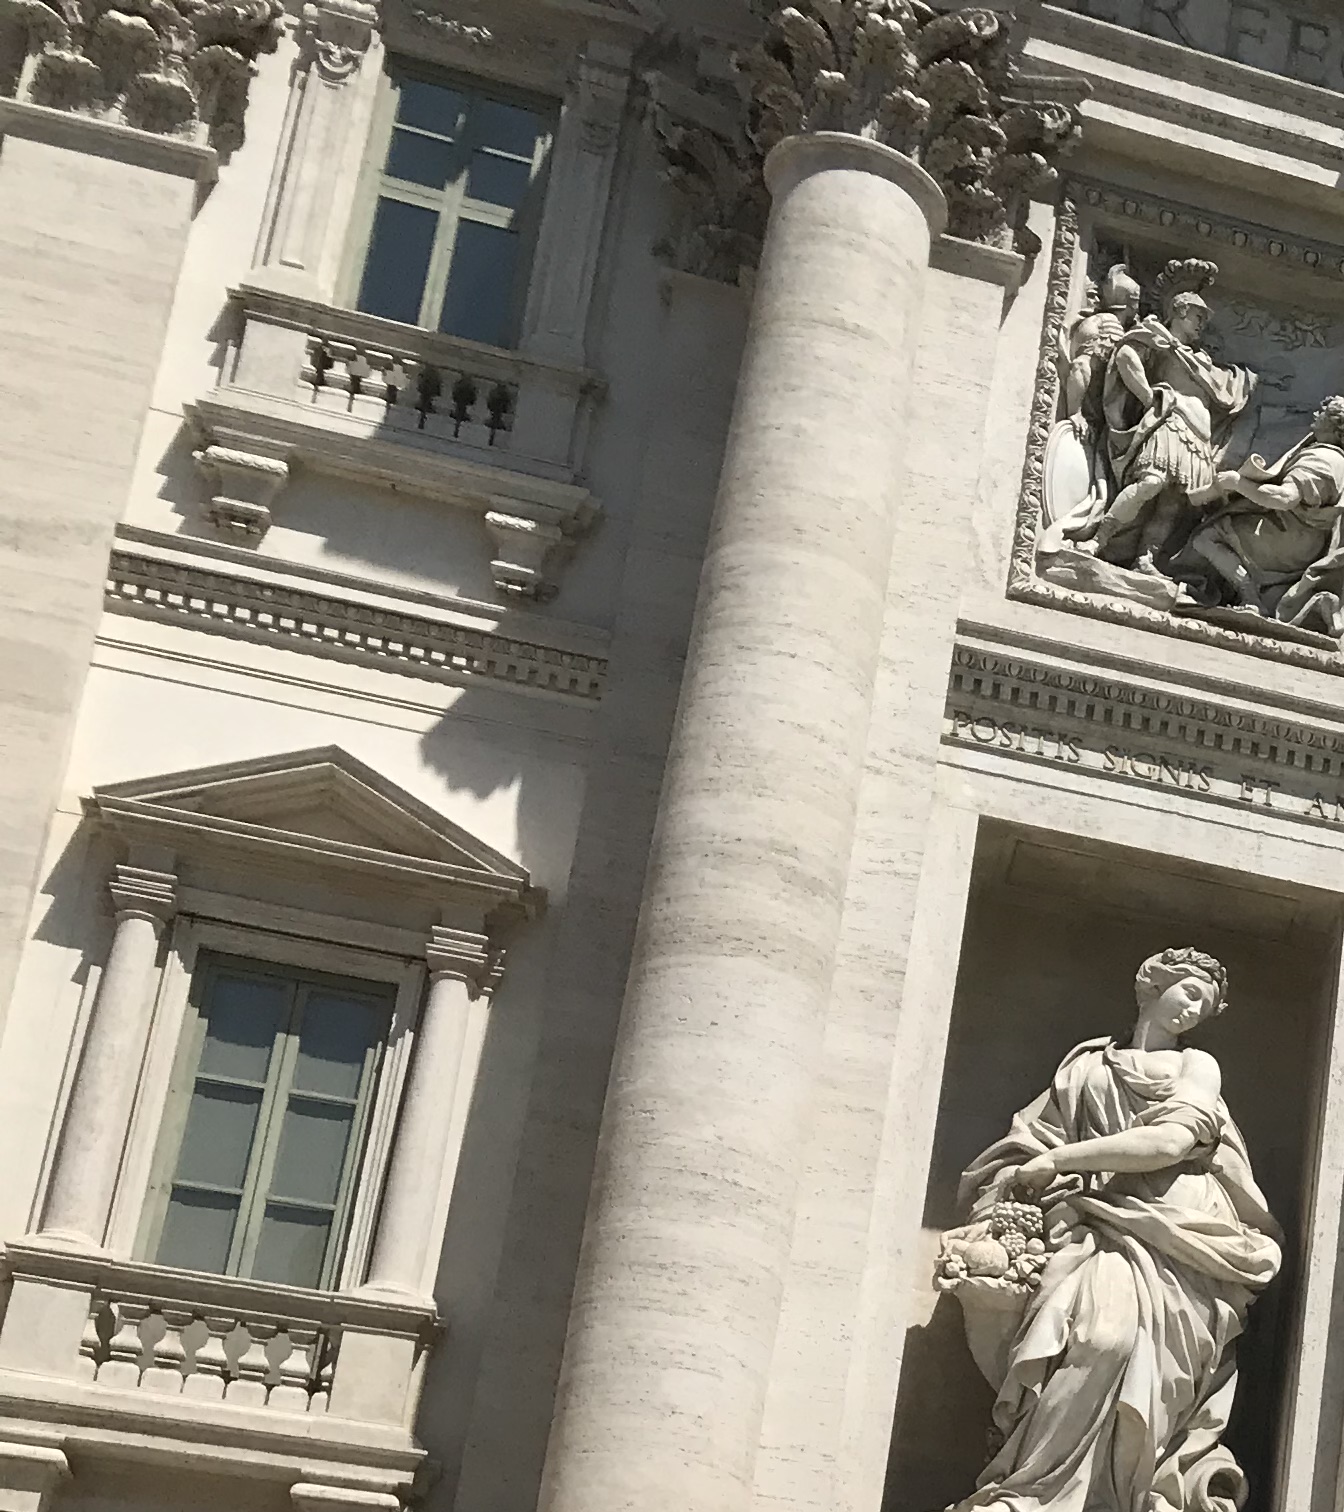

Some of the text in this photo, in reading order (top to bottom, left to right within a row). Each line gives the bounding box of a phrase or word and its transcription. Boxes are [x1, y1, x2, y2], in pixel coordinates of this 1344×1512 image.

[949, 707, 1084, 764] POSITIS
[1101, 742, 1215, 793] SIGNIS
[1238, 772, 1281, 808] ET
